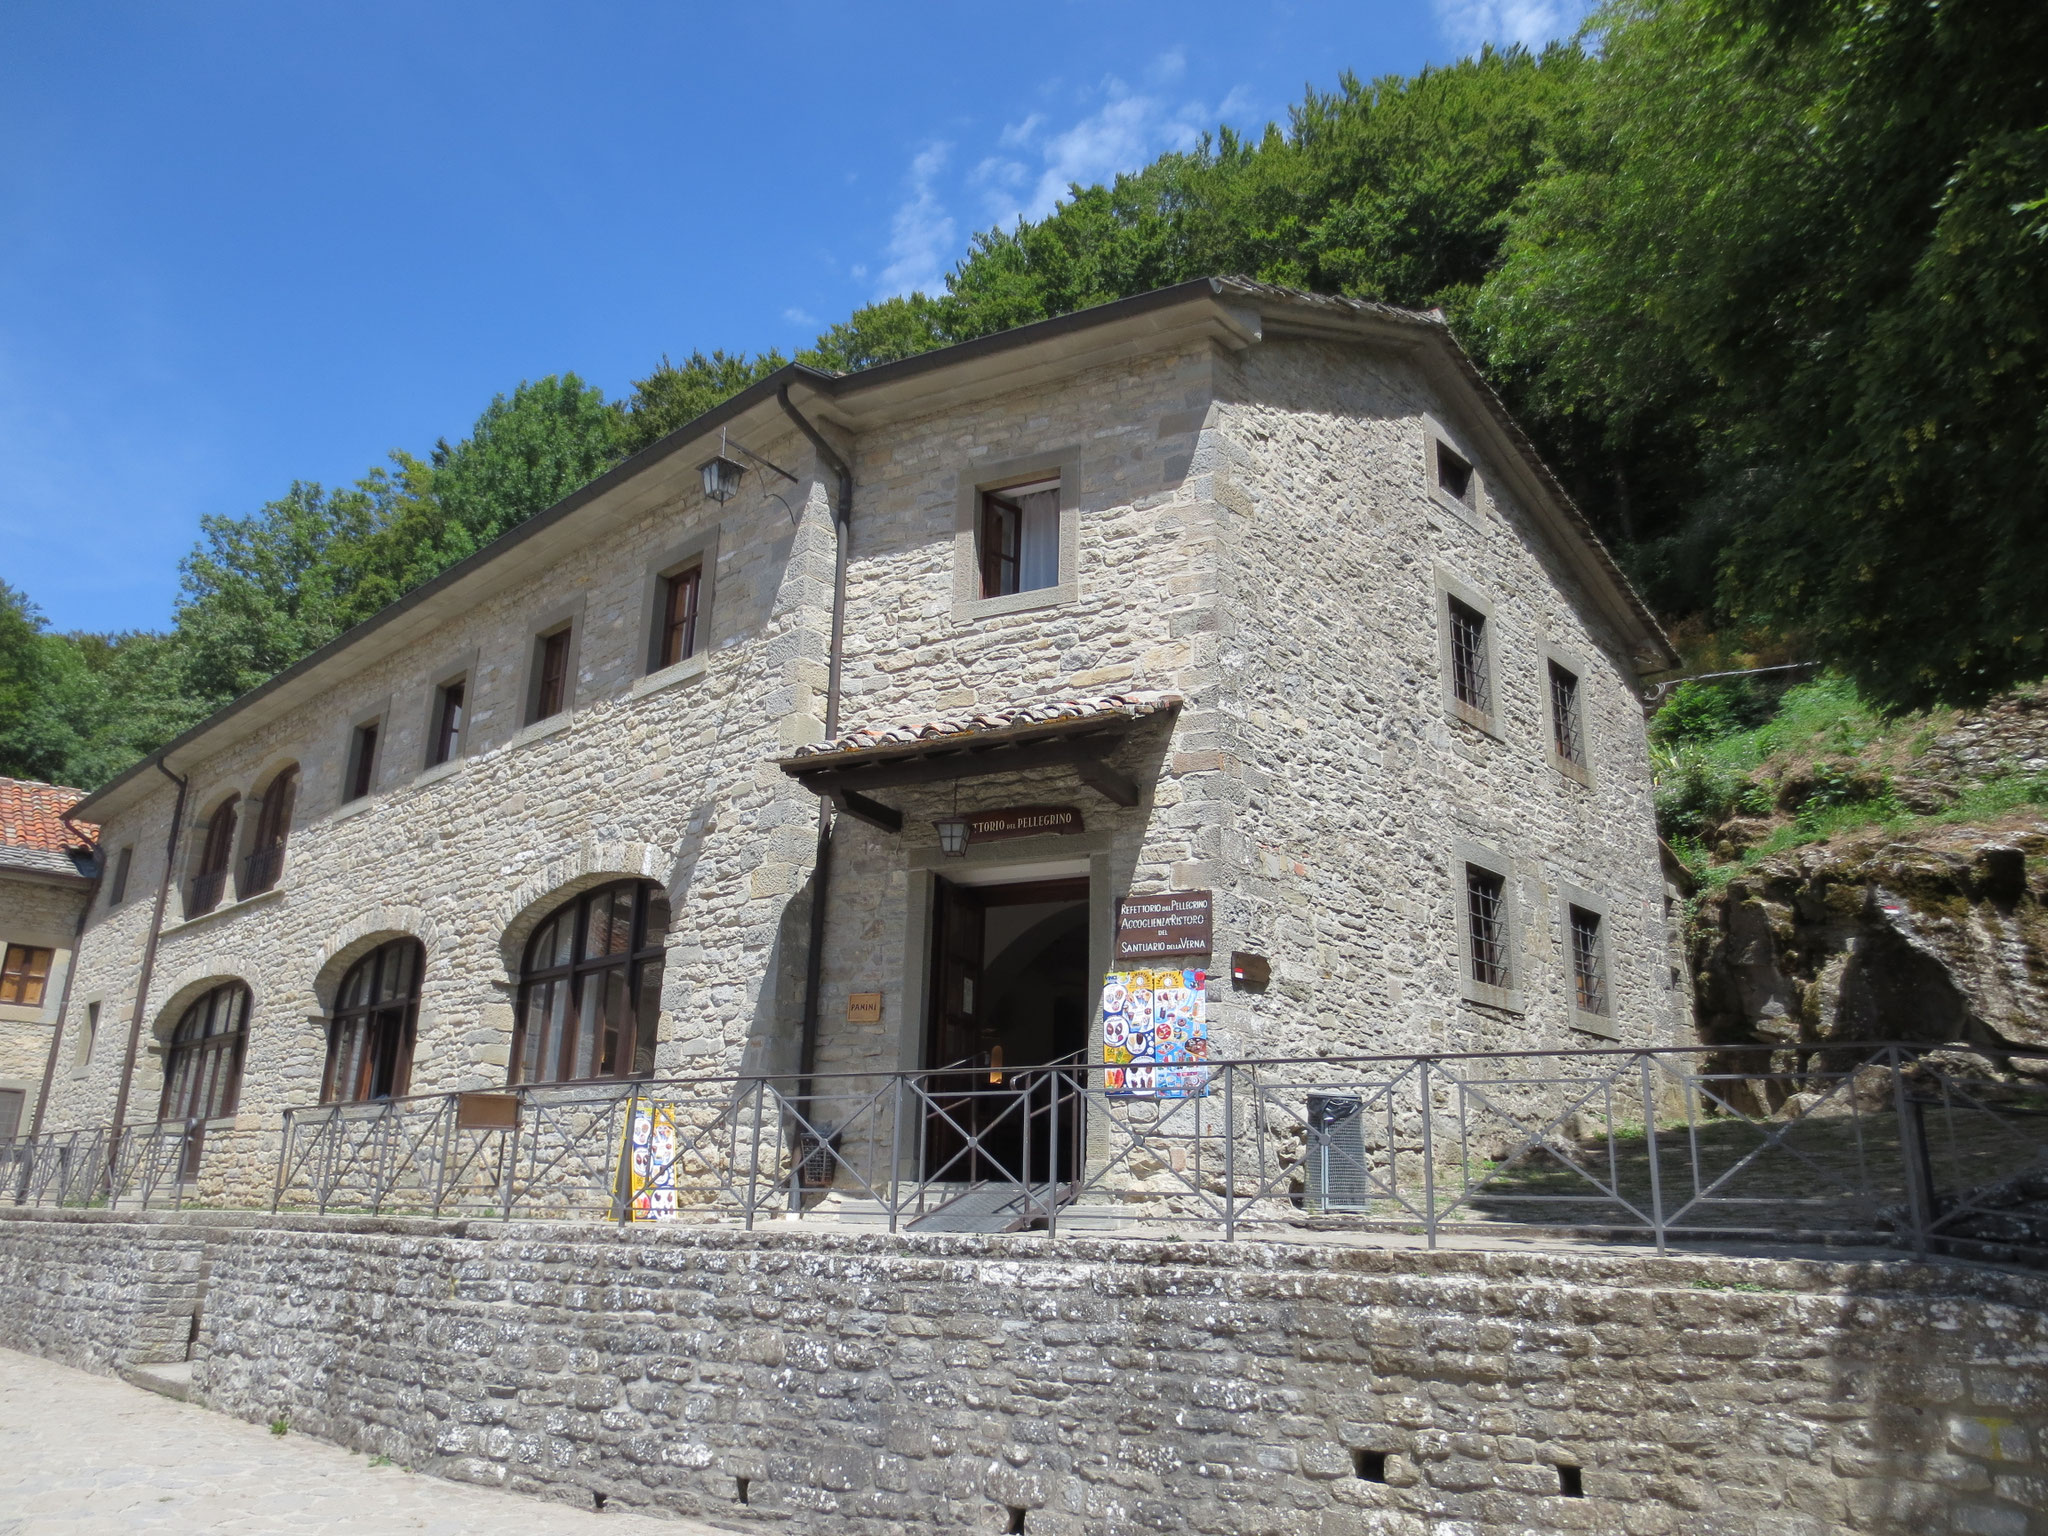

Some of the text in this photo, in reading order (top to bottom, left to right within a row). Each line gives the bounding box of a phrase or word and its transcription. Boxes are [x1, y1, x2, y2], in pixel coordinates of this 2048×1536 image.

[972, 819, 1005, 834] TTORIO
[1018, 813, 1072, 829] PELLEGRINO
[1121, 903, 1161, 915] REFETTORIO
[1171, 899, 1208, 911] PELLEGRINO
[1121, 941, 1165, 953] SANTUARIO
[1180, 937, 1206, 949] VERNA
